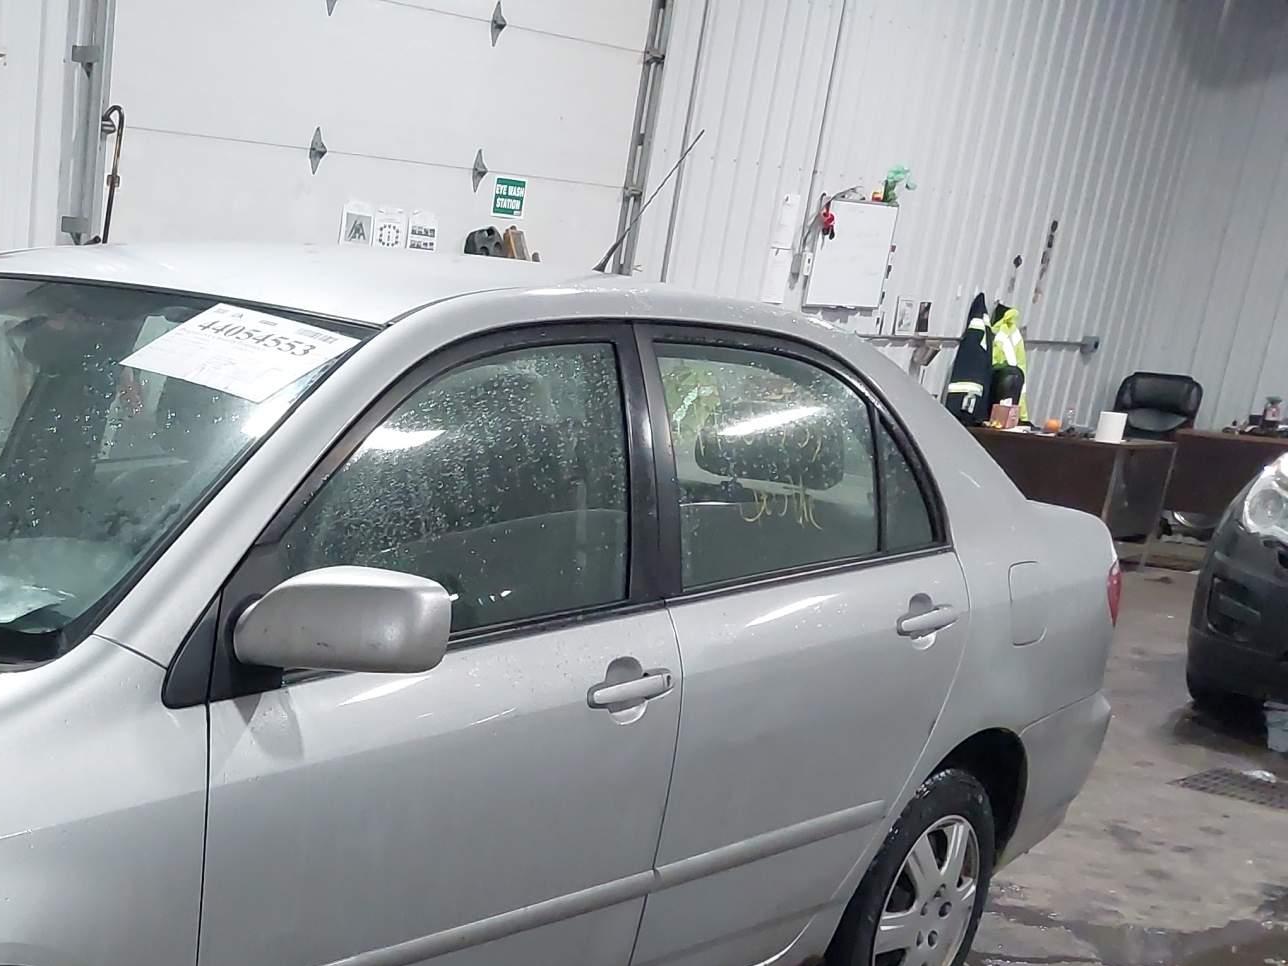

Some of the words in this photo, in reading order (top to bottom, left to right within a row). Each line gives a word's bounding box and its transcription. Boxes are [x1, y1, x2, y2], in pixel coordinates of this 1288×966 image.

[495, 184, 508, 196] EYE
[508, 185, 525, 197] WASH
[495, 197, 521, 210] STATION
[198, 320, 316, 356] 44054553
